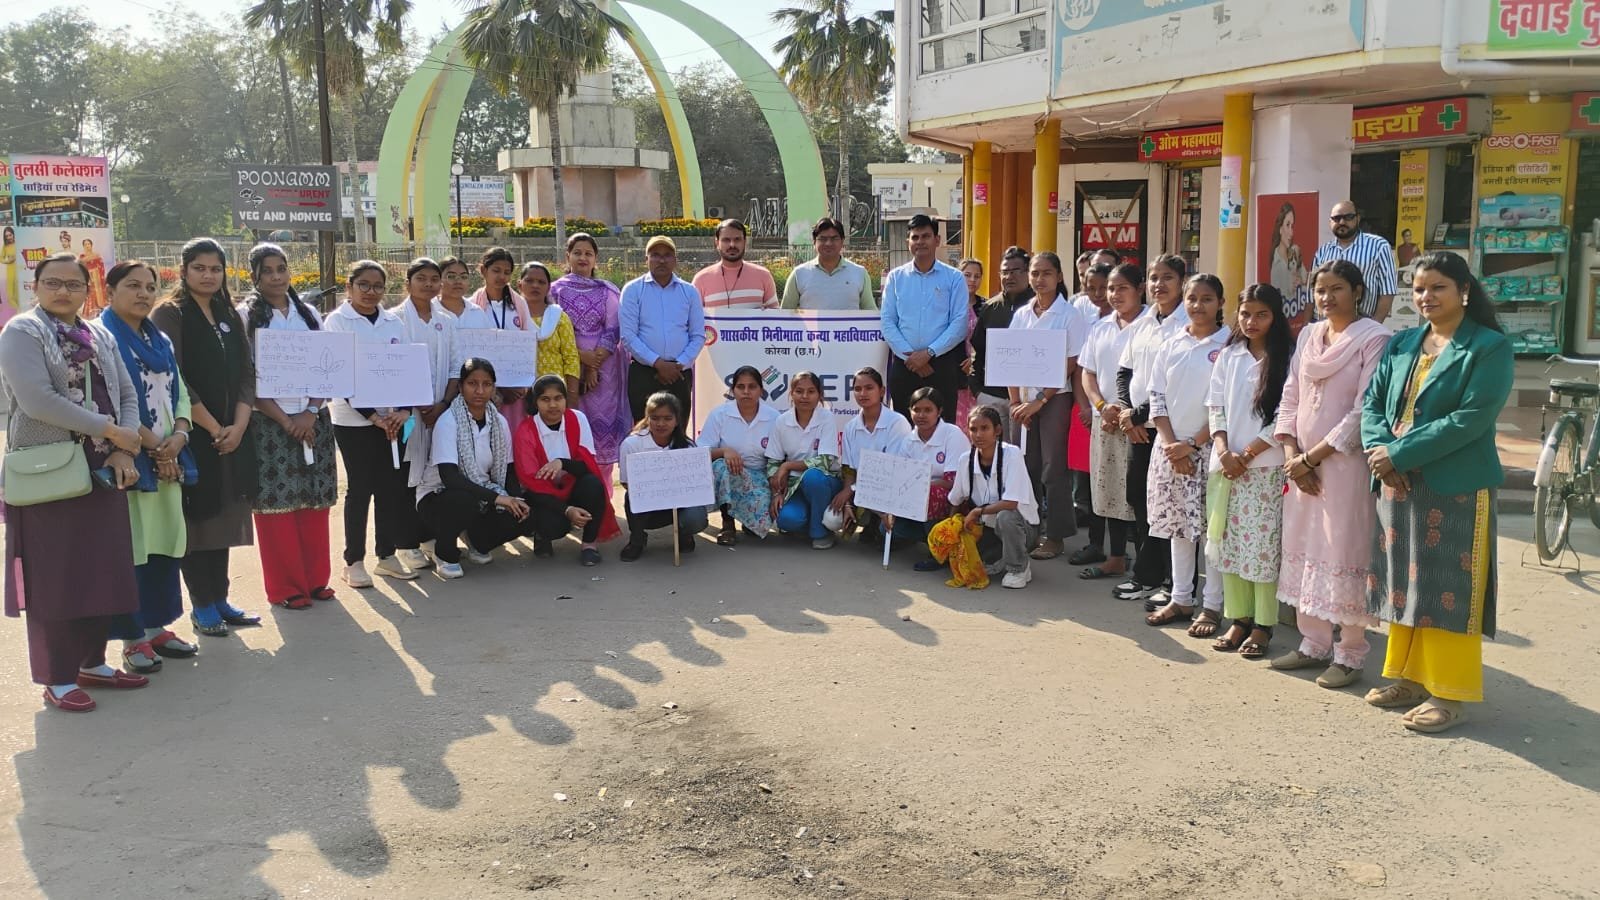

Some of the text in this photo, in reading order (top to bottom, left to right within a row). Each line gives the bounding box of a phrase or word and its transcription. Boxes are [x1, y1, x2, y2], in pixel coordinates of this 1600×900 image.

[1158, 132, 1222, 151] ओम महामाया
[13, 160, 49, 181] तुलसी
[52, 160, 104, 177] कलेक्शन
[239, 211, 260, 221] VEG
[264, 211, 286, 222] AND
[1099, 211, 1109, 219] 24
[1087, 226, 1137, 243] ATM
[720, 326, 885, 343] शासकीय मिनीमाता कन्या महाविद्यालय
[764, 344, 791, 356] कोरबा
